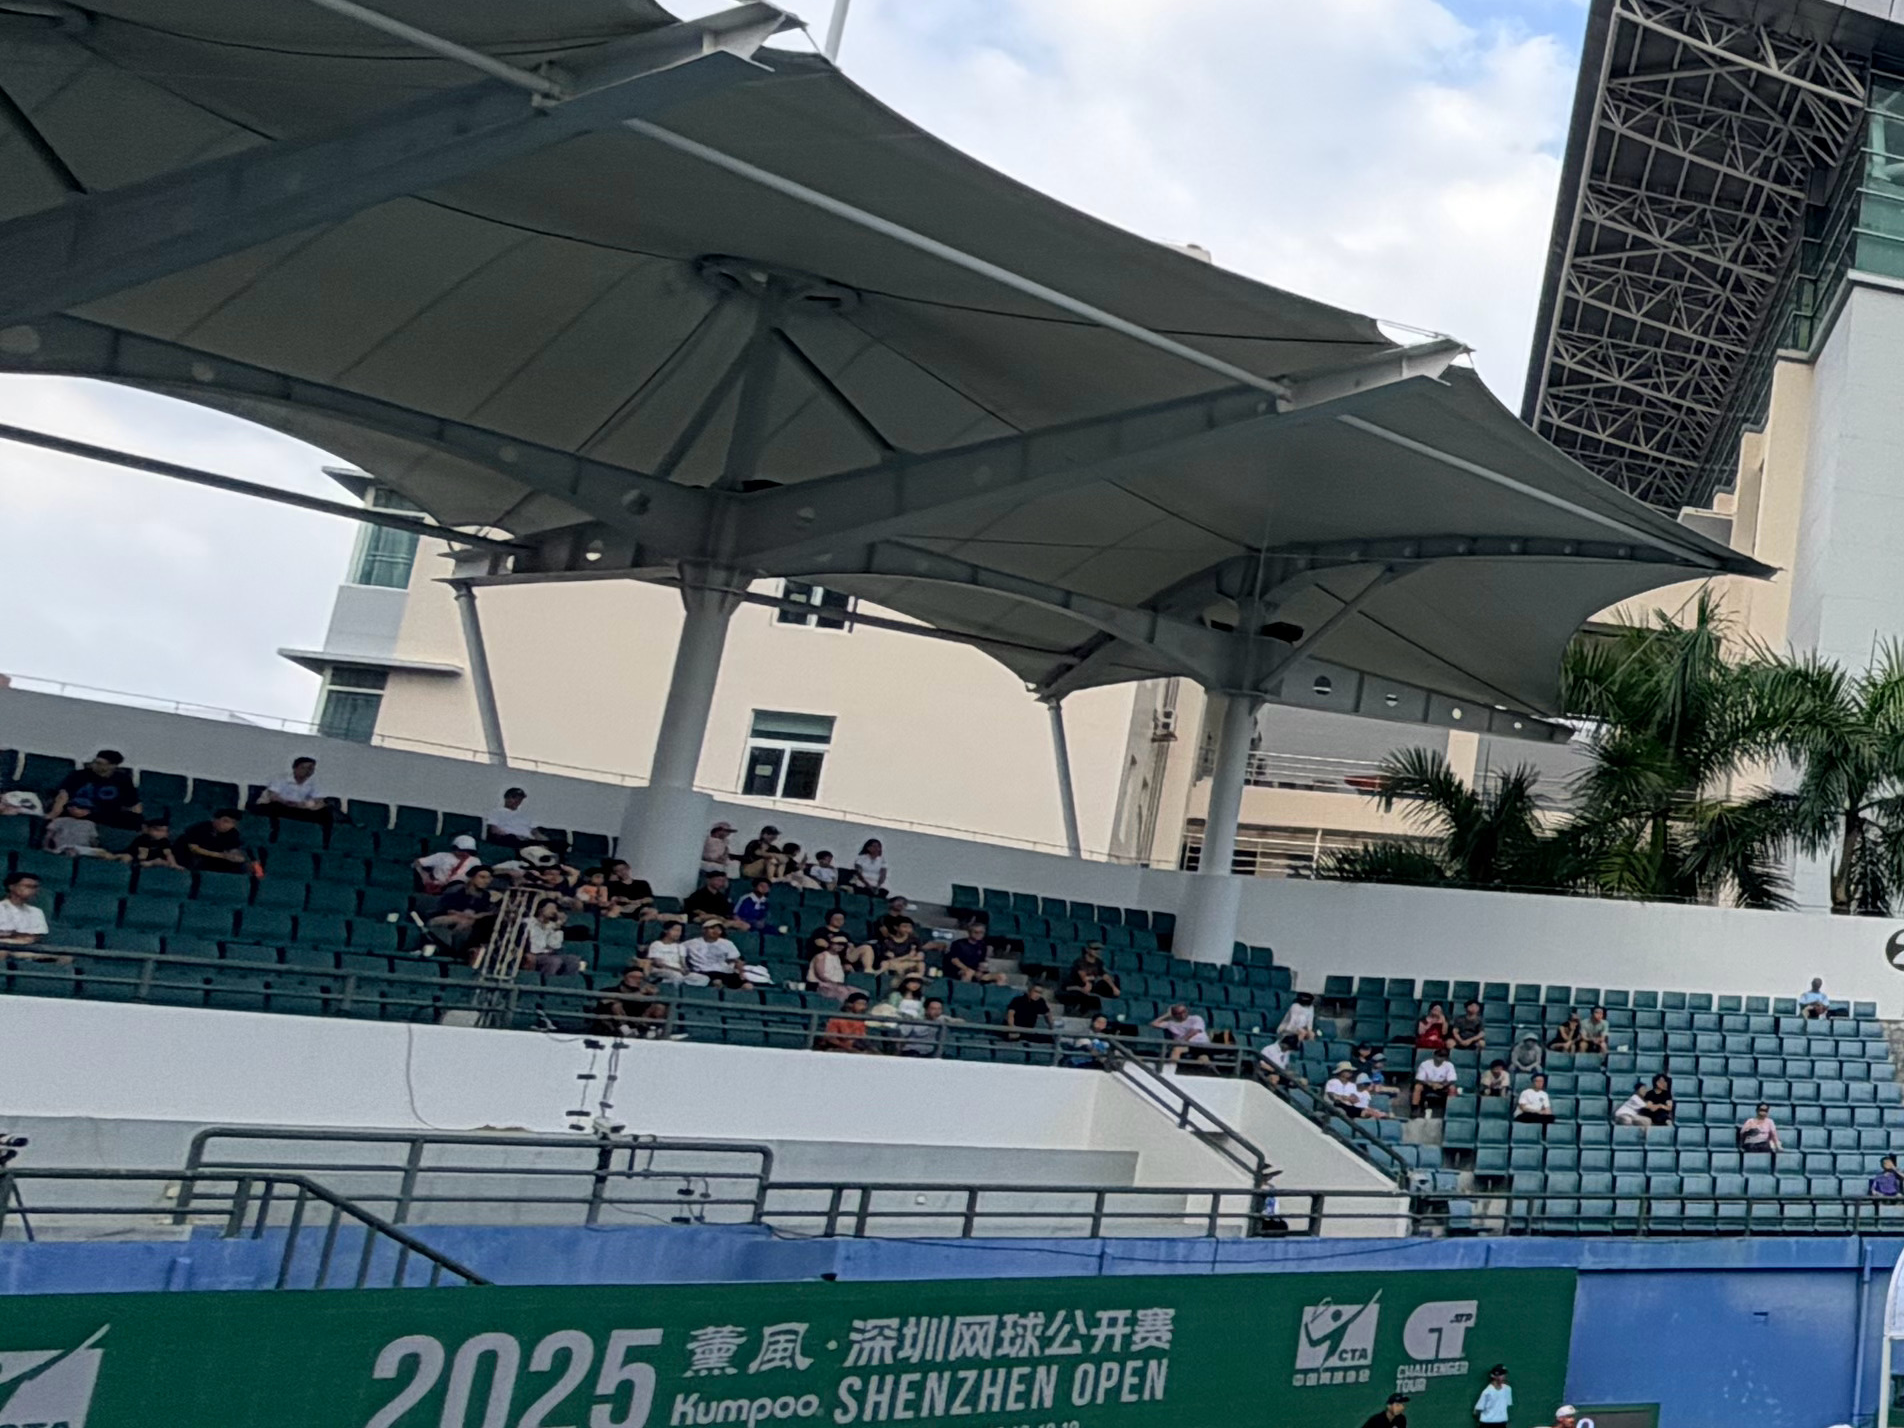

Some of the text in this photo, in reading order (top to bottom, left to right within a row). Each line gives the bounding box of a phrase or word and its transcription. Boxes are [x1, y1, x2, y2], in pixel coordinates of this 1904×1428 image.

[1337, 1348, 1369, 1363] CTA
[833, 1365, 1058, 1424] SHENZHEN
[1071, 1358, 1169, 1408] OPEN
